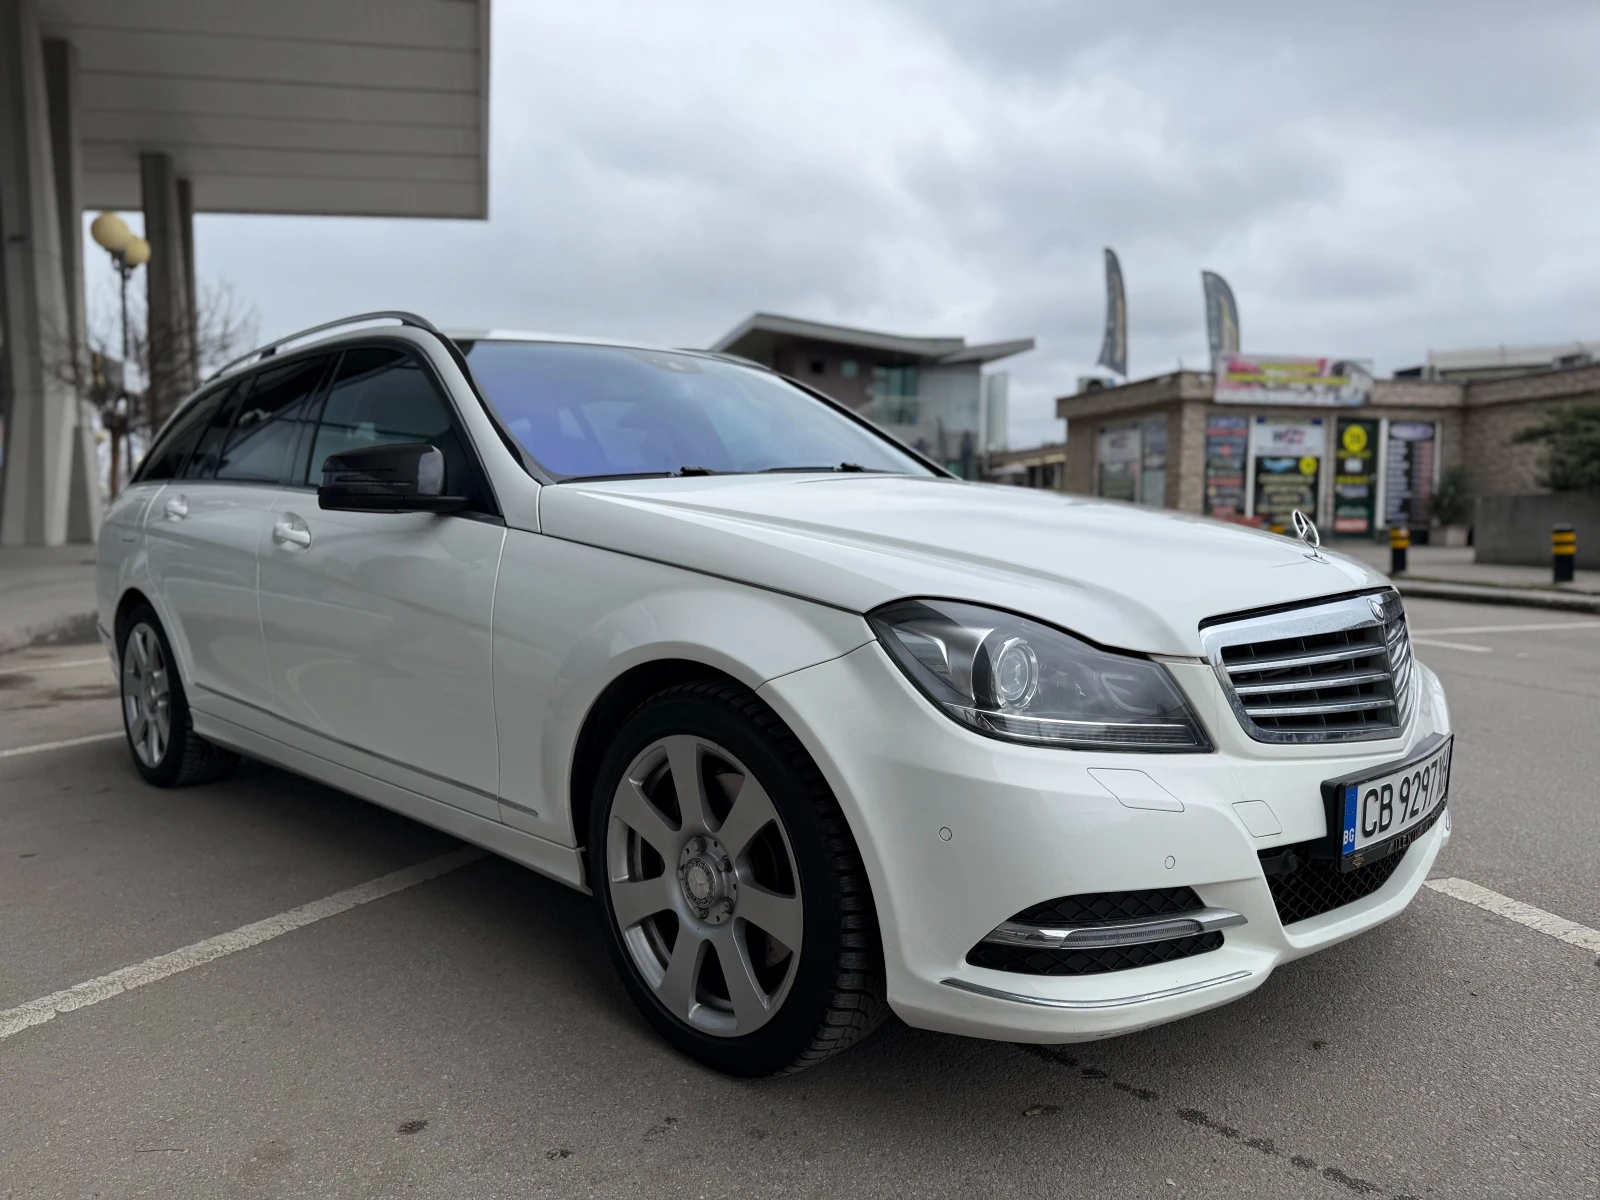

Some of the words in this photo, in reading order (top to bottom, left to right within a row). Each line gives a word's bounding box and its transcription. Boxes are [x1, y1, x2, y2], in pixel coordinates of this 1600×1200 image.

[1362, 783, 1393, 838] CB
[1399, 758, 1438, 824] 9297
[1343, 828, 1354, 845] BG
